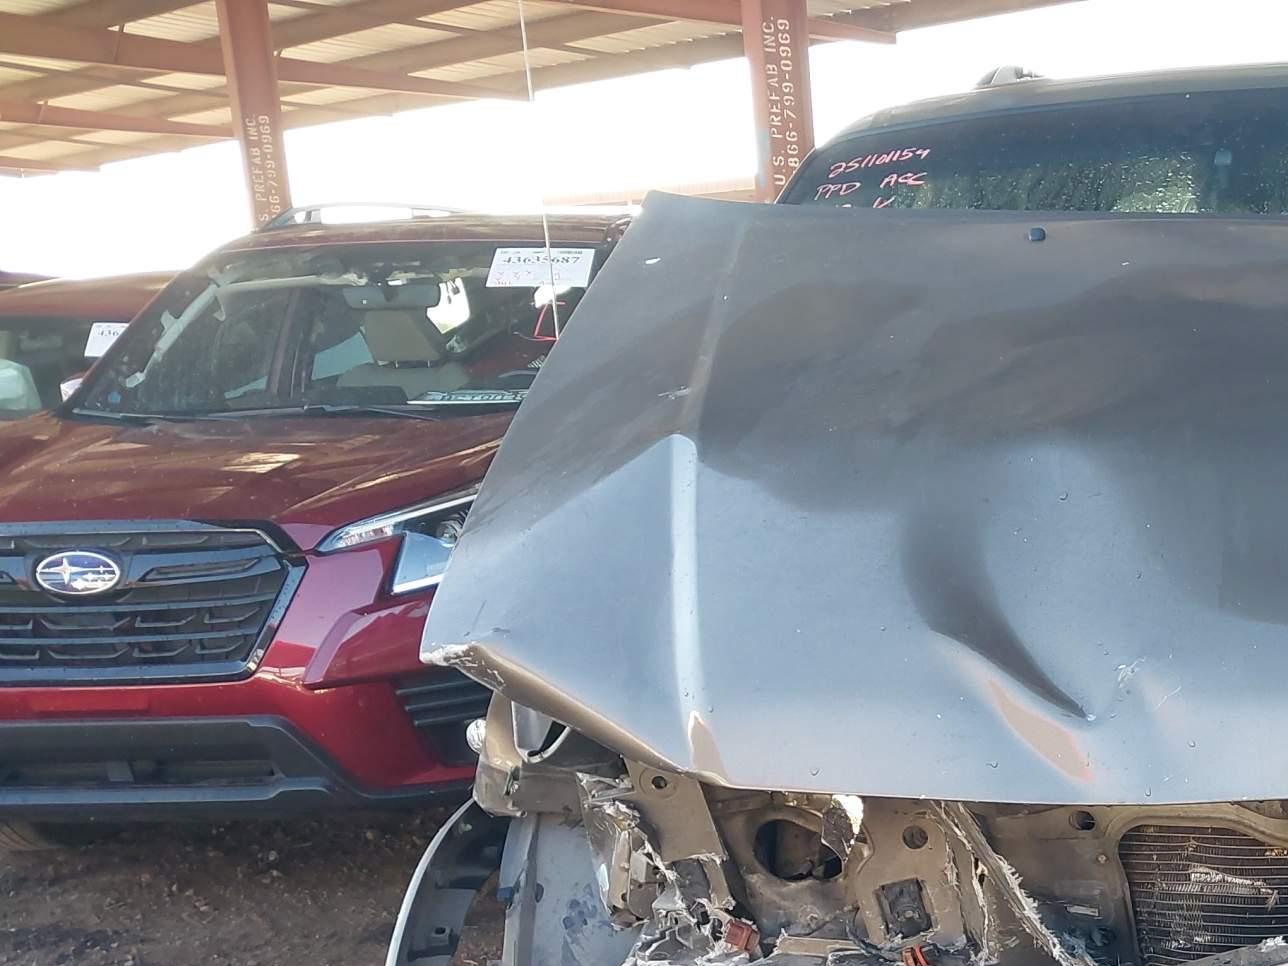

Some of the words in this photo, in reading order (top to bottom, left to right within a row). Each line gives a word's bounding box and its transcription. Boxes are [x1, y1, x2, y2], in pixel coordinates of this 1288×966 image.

[762, 16, 777, 52] INC.
[765, 63, 783, 139] PREFAB
[777, 18, 800, 174] -866-799-0969
[249, 147, 267, 201] PREFAB
[258, 115, 281, 218] 66-799-0969
[773, 150, 786, 186] U.S.
[814, 182, 862, 201] PPD
[879, 172, 928, 189] ACC
